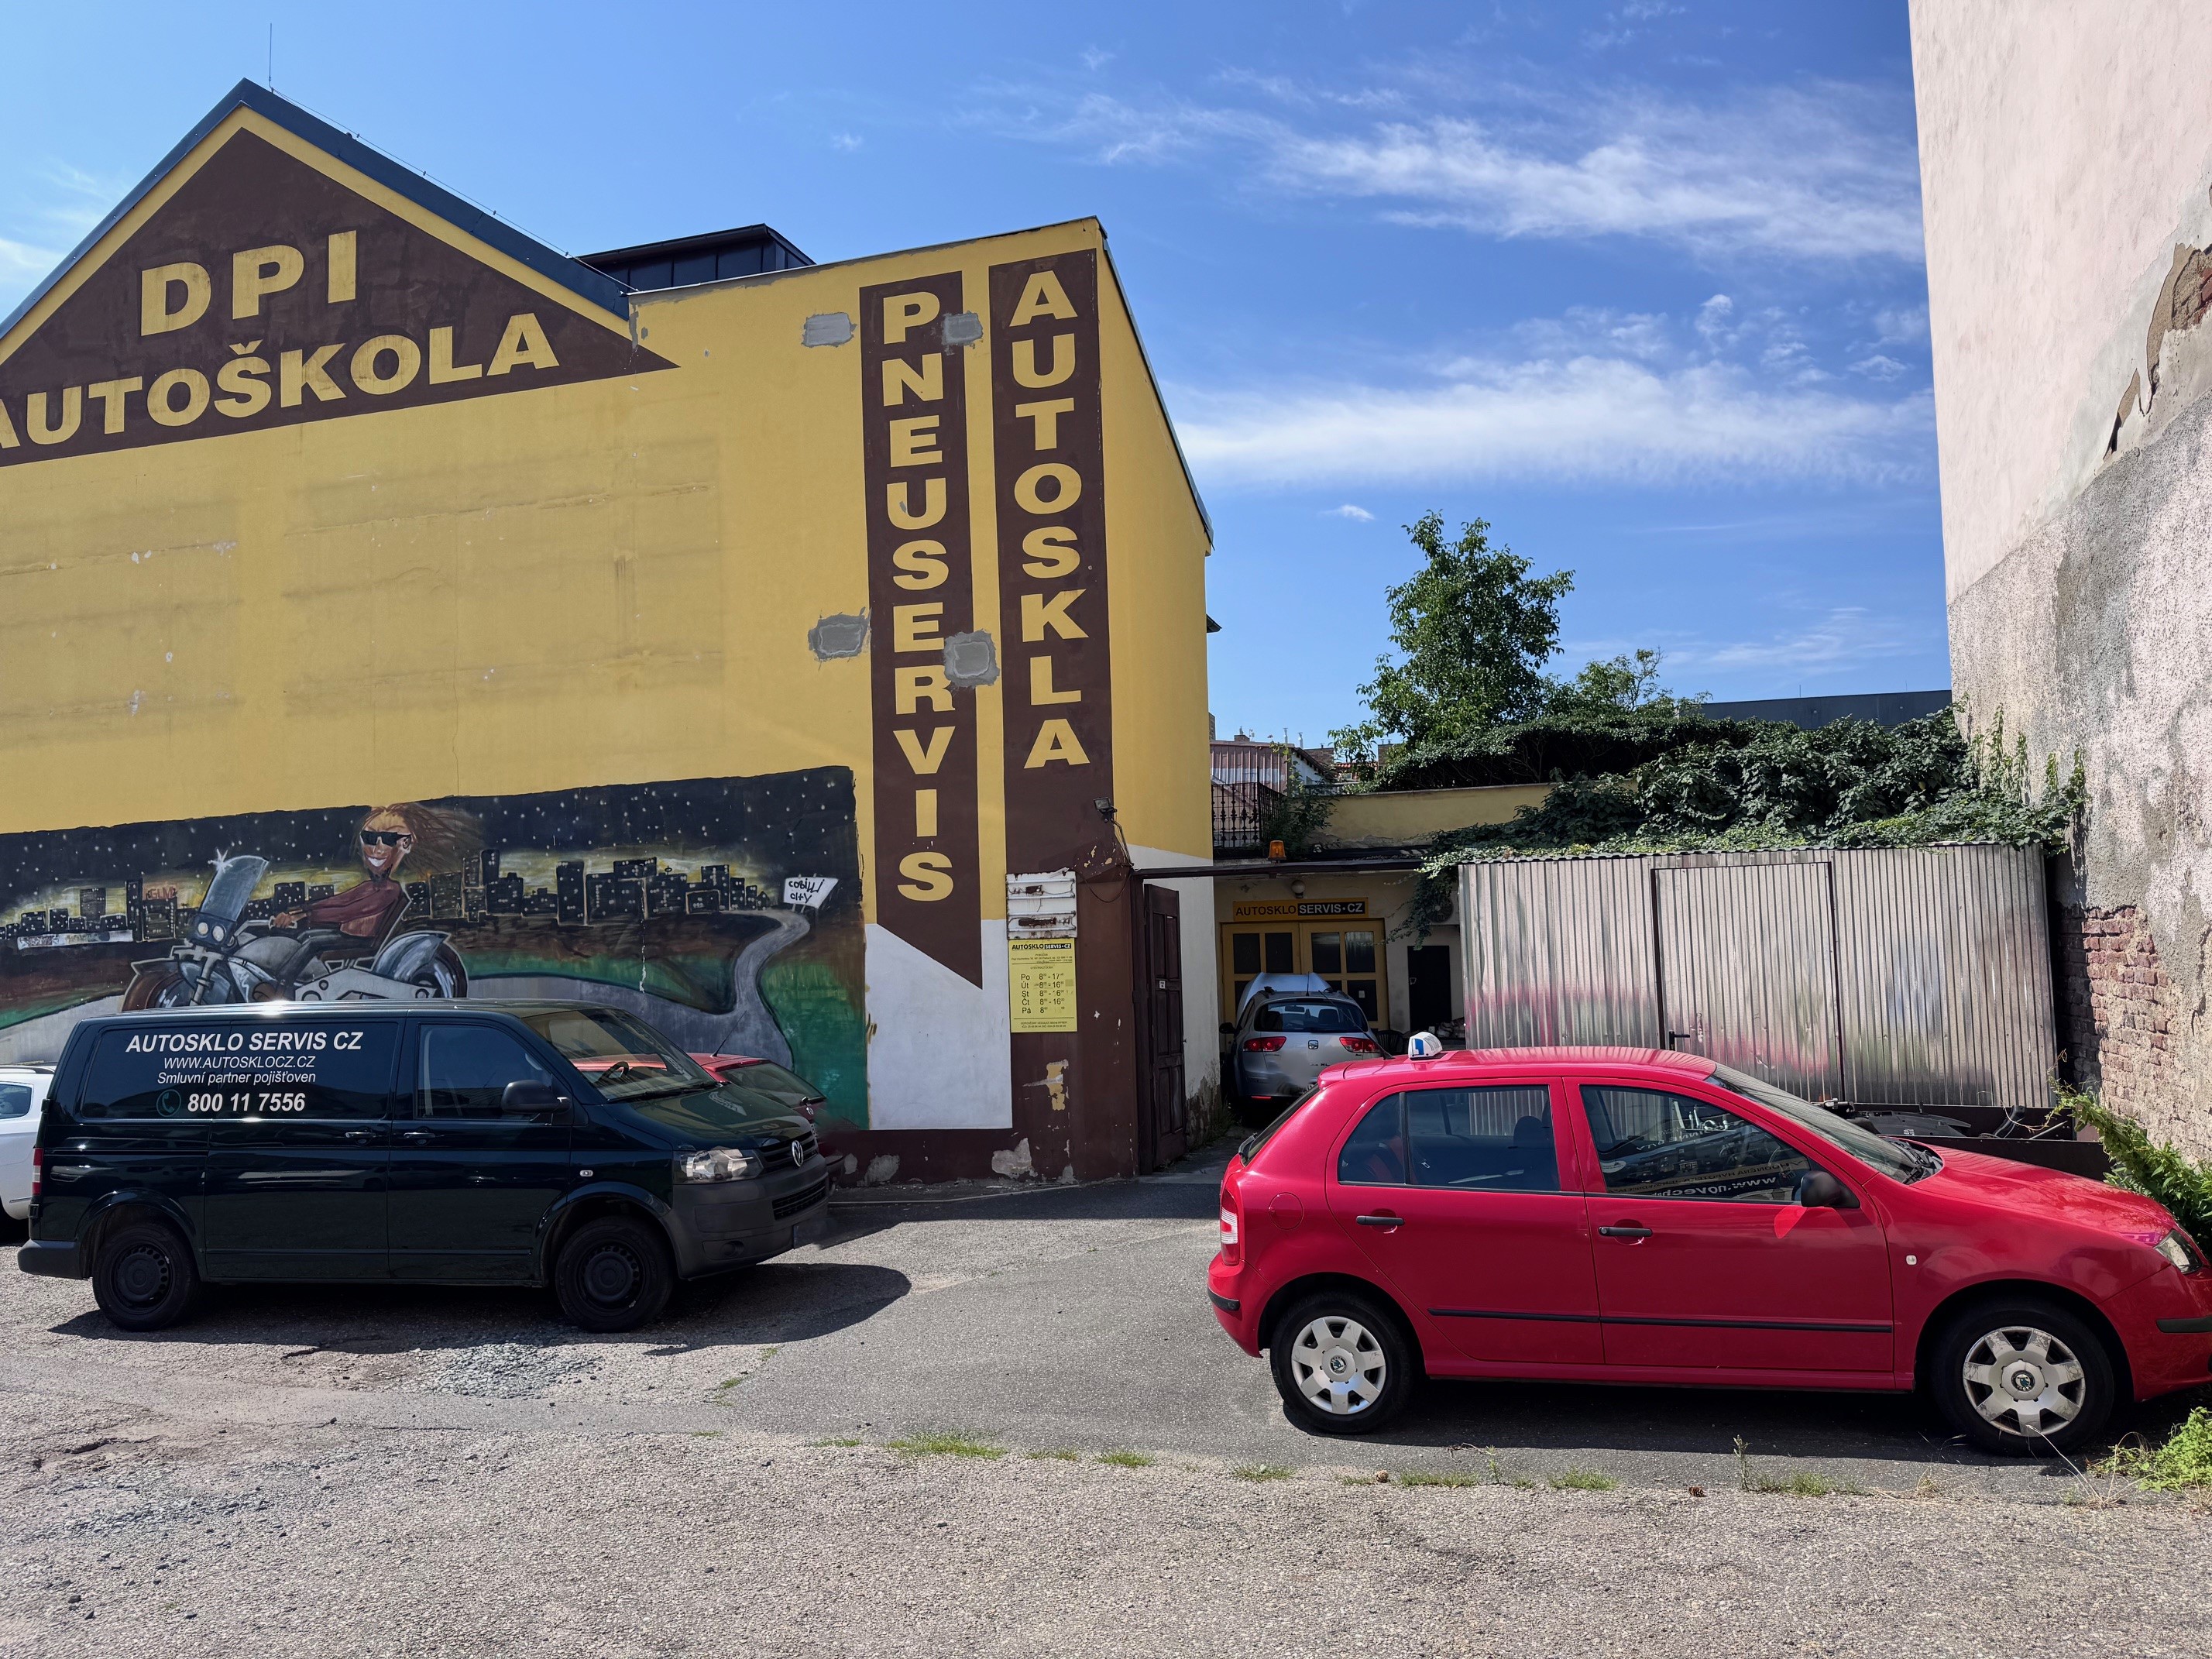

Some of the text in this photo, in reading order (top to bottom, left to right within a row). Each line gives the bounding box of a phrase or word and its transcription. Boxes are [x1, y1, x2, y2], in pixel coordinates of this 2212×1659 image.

[141, 230, 357, 336] DPI
[1008, 270, 1090, 769] AUTOSKLA
[881, 291, 956, 902] PNEUSERVIS
[1235, 905, 1297, 916] AUTOSKLO
[125, 1031, 364, 1053] AUTOSKLO SERVIS CZ
[164, 1056, 316, 1069] WWW.AUTOSKLOCZ.CZ
[157, 1070, 316, 1086] Smluvní partner pojišťoven
[187, 1092, 306, 1112] 800 11 7556
